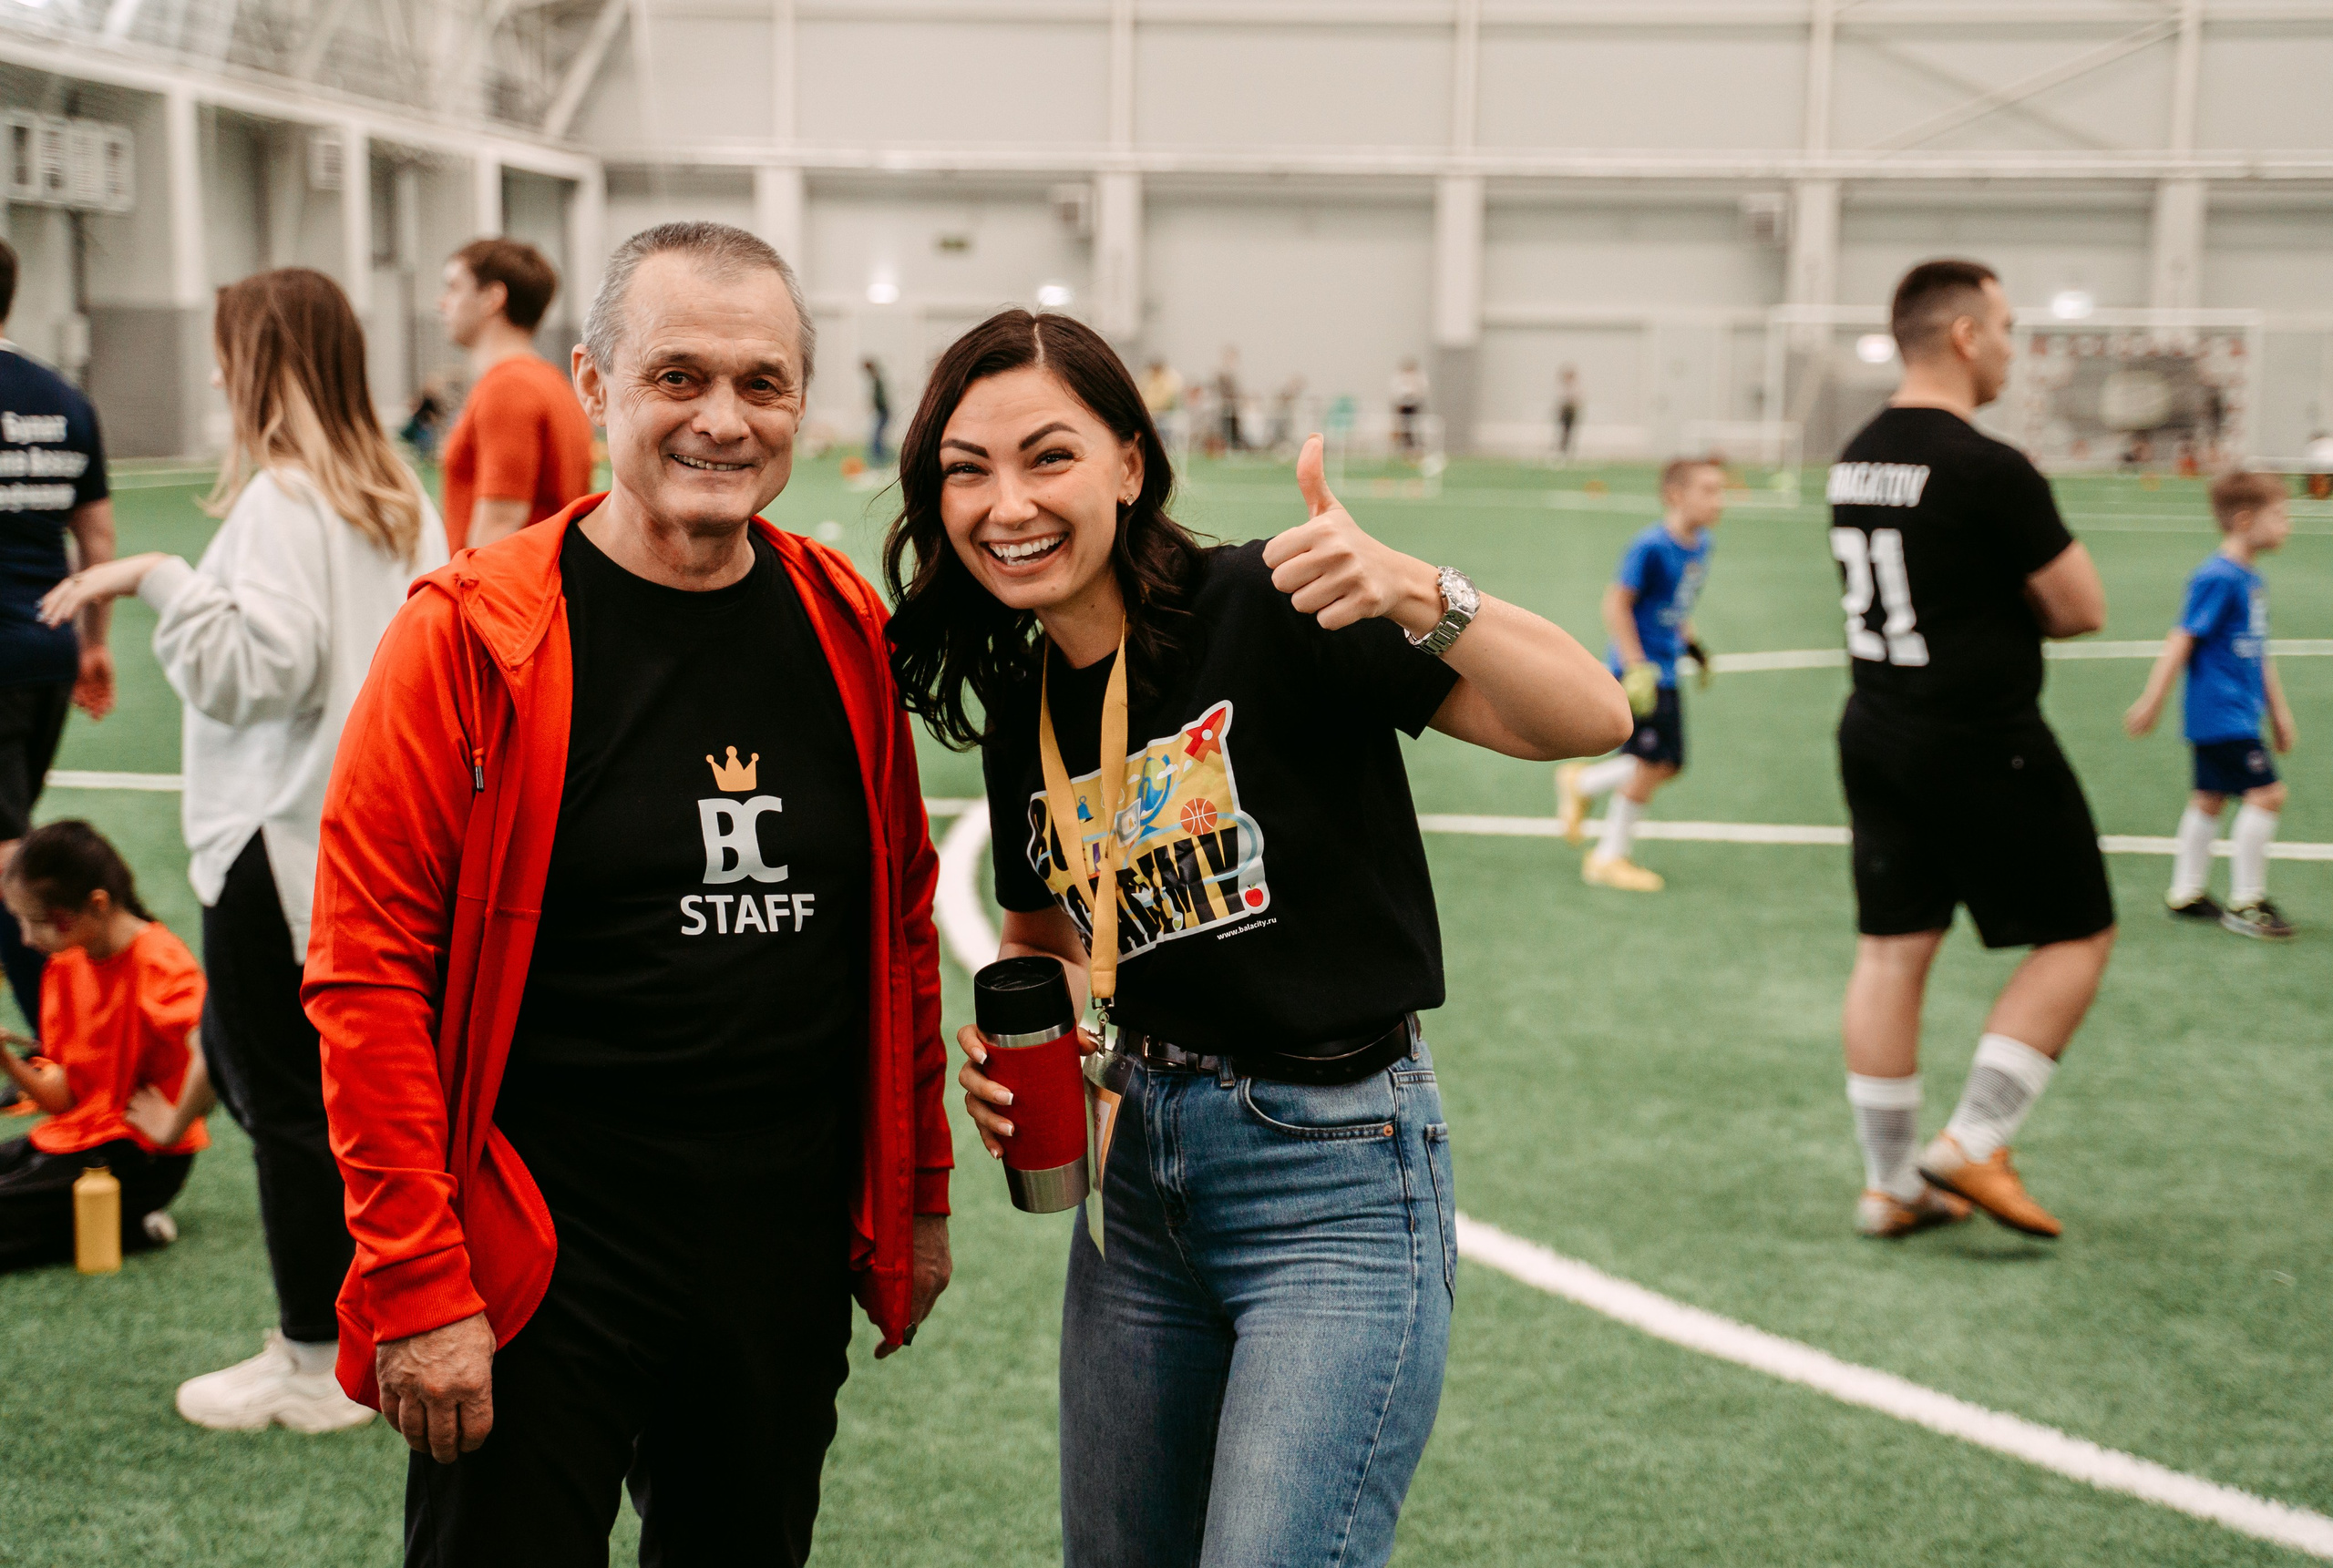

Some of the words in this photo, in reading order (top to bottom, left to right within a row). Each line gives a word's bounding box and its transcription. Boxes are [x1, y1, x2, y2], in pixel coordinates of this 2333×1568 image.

[1829, 526, 1929, 666] 21
[697, 795, 788, 884] BC
[680, 893, 816, 936] STAFF
[1053, 825, 1246, 957] ADEMY
[1217, 917, 1277, 940] www.balacity.ru
